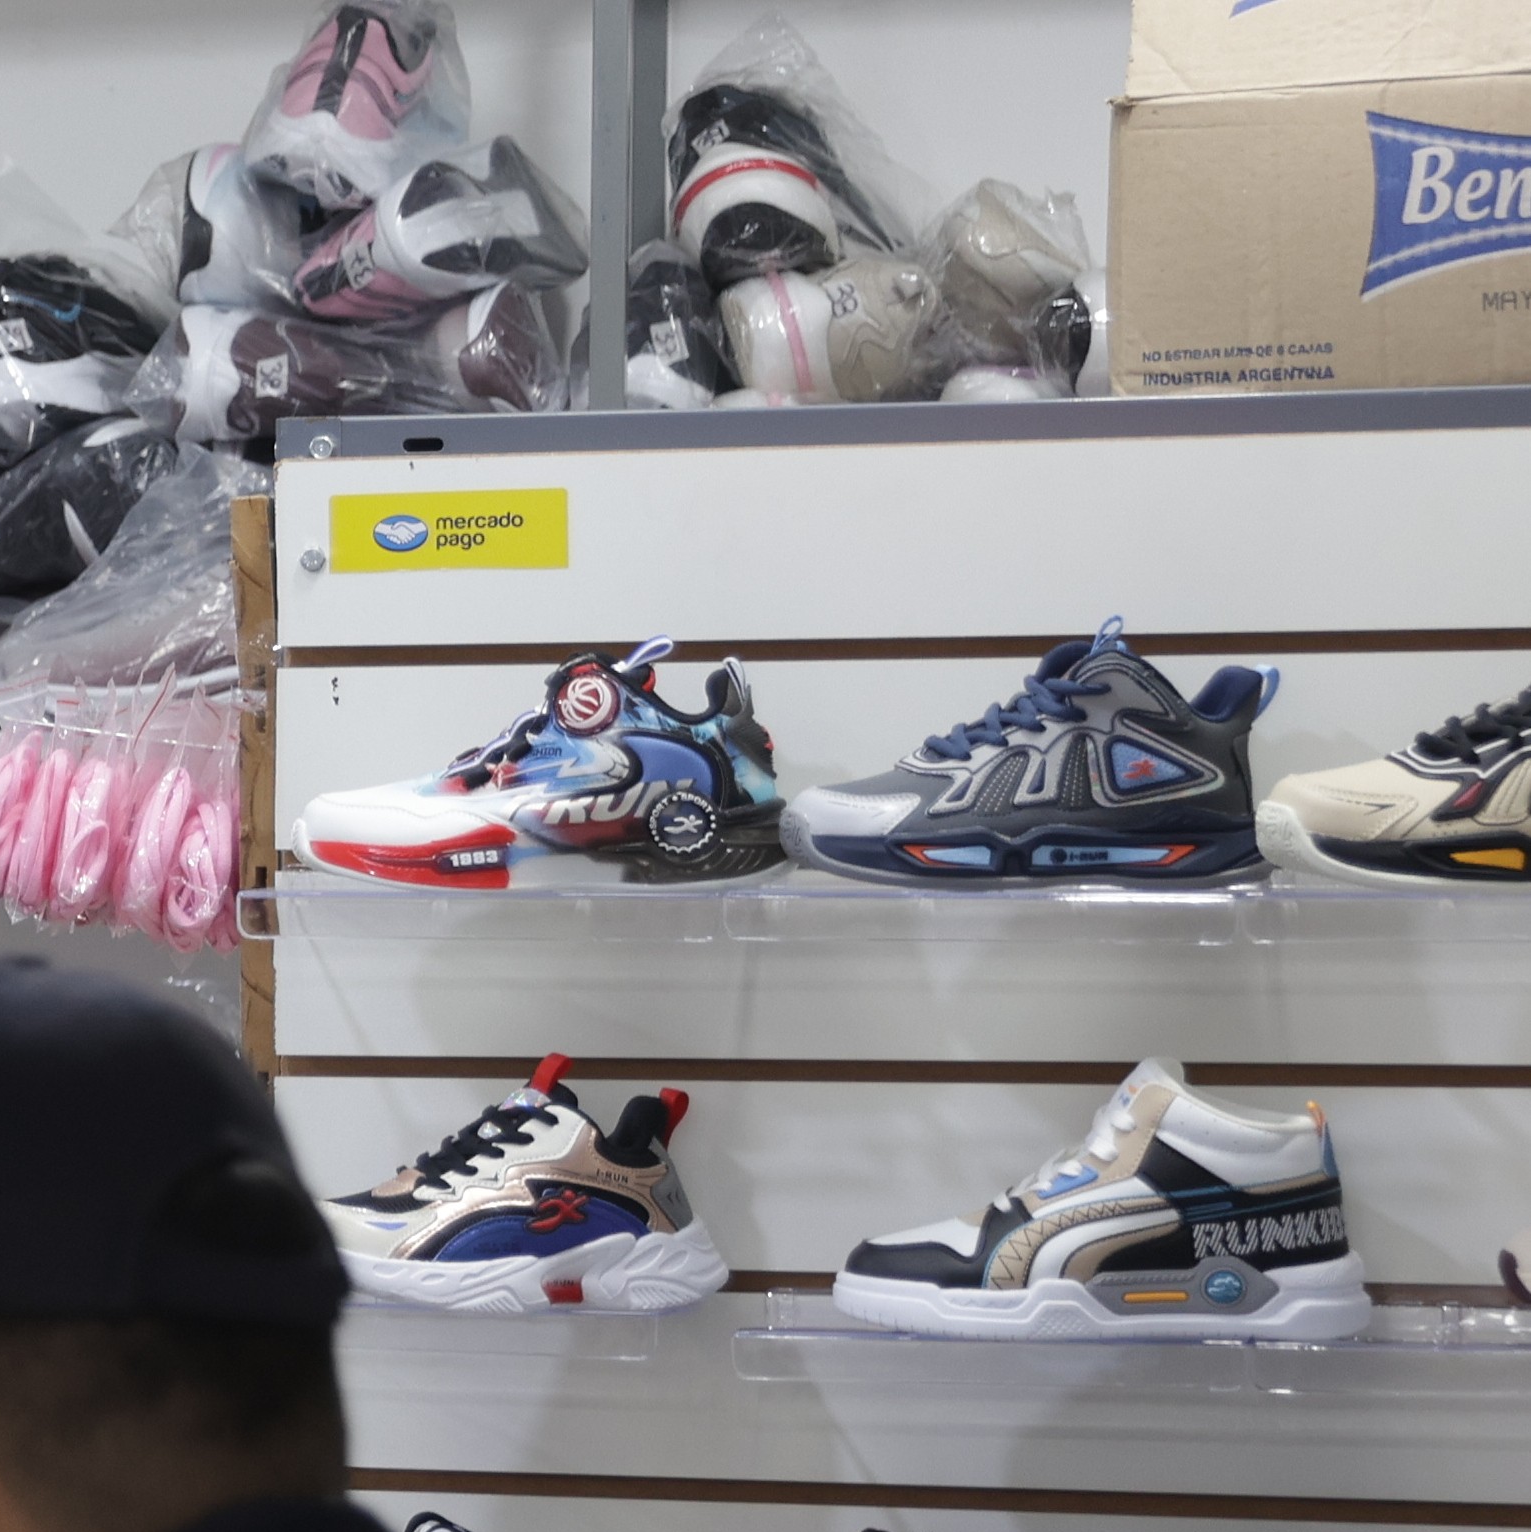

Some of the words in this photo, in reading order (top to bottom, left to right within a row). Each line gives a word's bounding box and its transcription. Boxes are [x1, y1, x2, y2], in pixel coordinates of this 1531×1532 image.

[1143, 351, 1162, 362] NO
[1143, 370, 1232, 386] INDUSTRIA
[436, 511, 524, 530] mercado
[436, 531, 486, 551] pago
[596, 1168, 629, 1184] I-RUN
